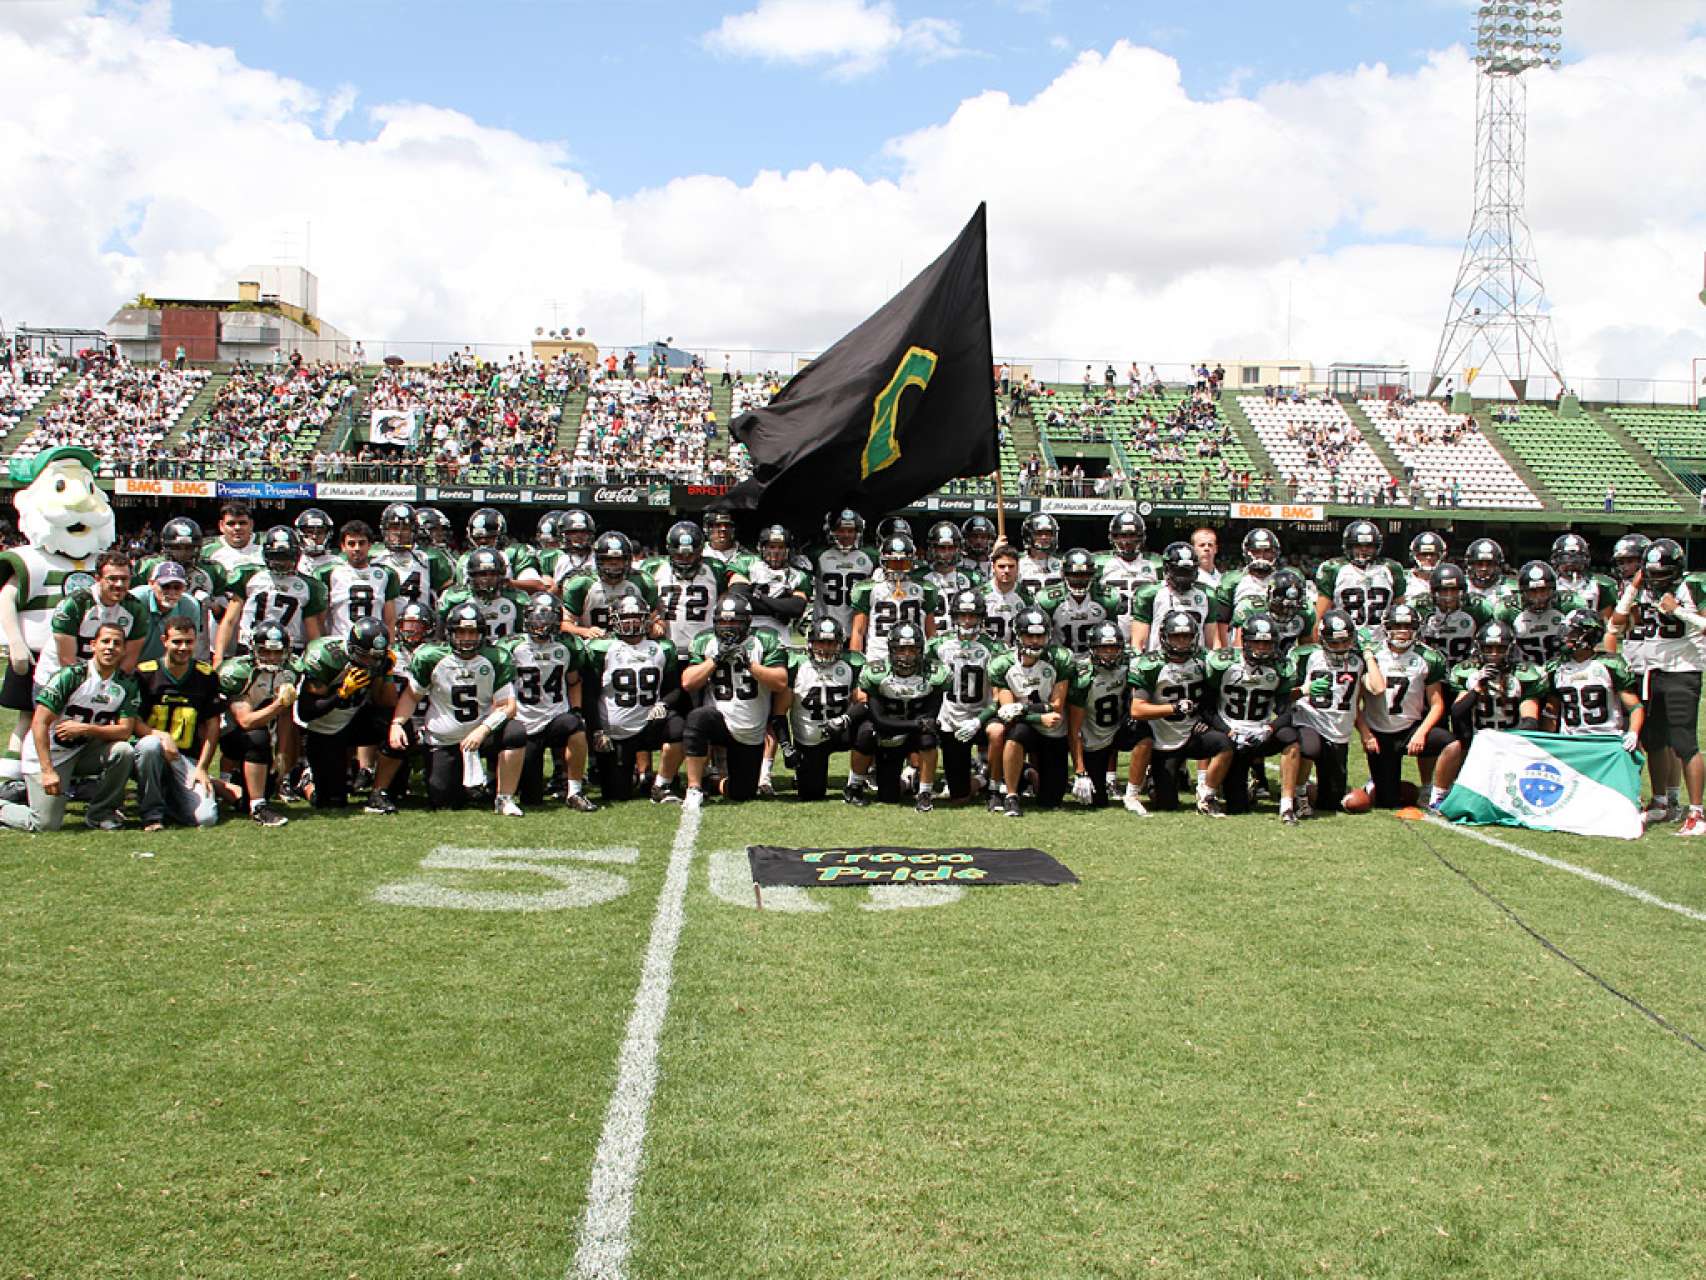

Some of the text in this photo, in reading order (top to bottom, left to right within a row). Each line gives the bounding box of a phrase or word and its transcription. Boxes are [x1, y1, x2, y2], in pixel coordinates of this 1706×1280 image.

[127, 479, 162, 493] BMG
[173, 481, 208, 495] BMG
[687, 485, 727, 497] BRASI
[1239, 504, 1272, 518] BMG
[1282, 505, 1313, 519] BMG
[252, 591, 299, 627] 17
[349, 584, 374, 622] 8
[658, 584, 710, 621] 72
[517, 664, 564, 705] 34
[612, 667, 660, 708] 99
[801, 686, 849, 719] 45
[1385, 676, 1411, 715] 7
[451, 684, 479, 723] 5
[1094, 694, 1119, 728] 8
[1223, 685, 1271, 721] 36
[1558, 684, 1608, 726] 89
[815, 864, 989, 882] Pride
